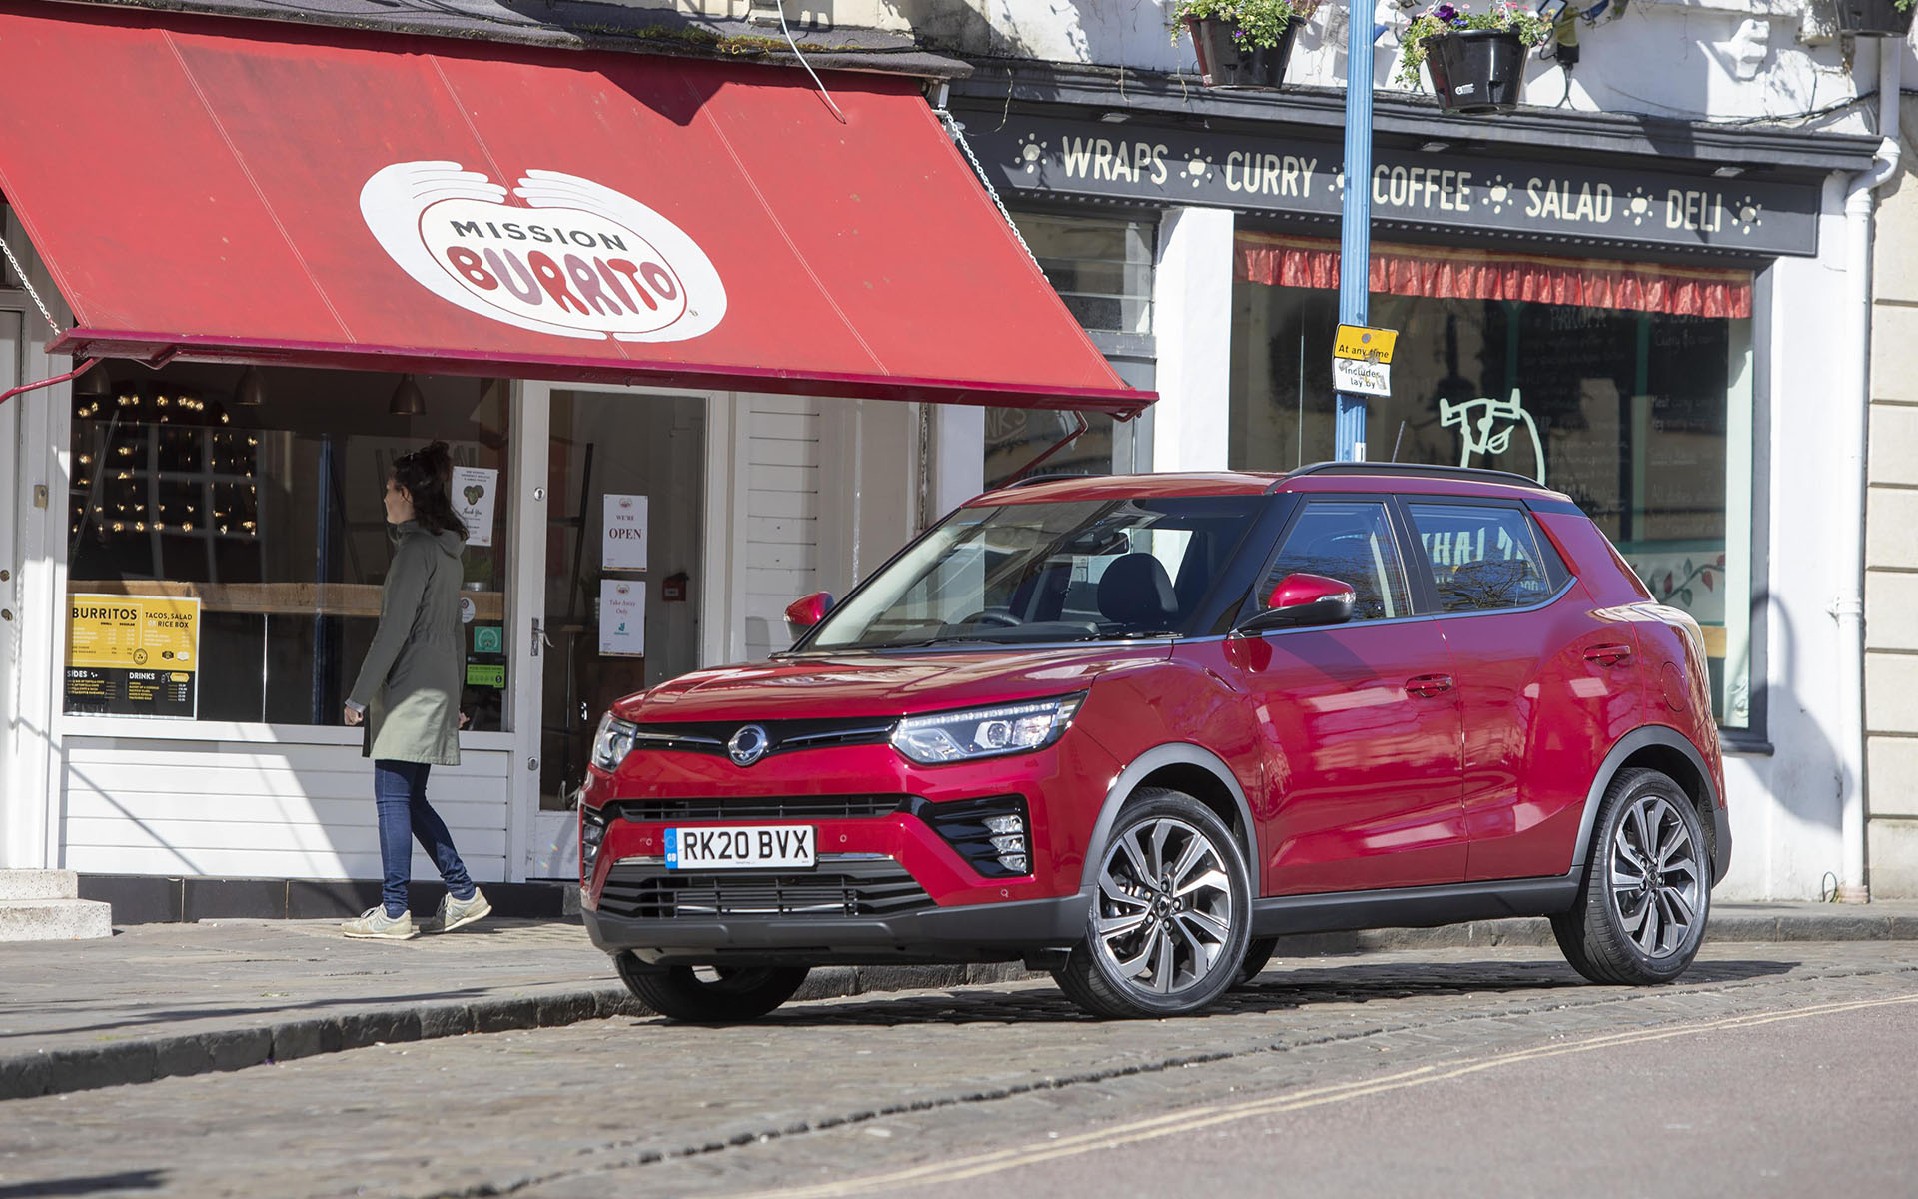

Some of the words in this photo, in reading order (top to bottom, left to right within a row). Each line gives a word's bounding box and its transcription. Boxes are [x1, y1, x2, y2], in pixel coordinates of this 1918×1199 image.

[1062, 136, 1169, 185] WRAPS
[1224, 151, 1318, 198] CURRY
[1372, 164, 1473, 212] COFFEE
[1525, 177, 1613, 223] SALAD
[1665, 188, 1722, 232] DELI
[450, 220, 629, 252] MISSION
[446, 246, 678, 317] BURRITO
[1338, 344, 1349, 354] At
[1351, 346, 1367, 357] any
[1369, 348, 1390, 359] time
[1344, 366, 1381, 378] Includes
[1350, 377, 1363, 388] lay
[1365, 379, 1376, 389] by
[608, 527, 642, 540] OPEN
[72, 607, 137, 620] BURRITOS
[145, 611, 170, 620] TACOS,
[67, 670, 88, 678] SIDES
[129, 672, 155, 680] DRINKS
[683, 831, 750, 860] RK20
[757, 830, 809, 859] BVX
[666, 852, 677, 862] GB
